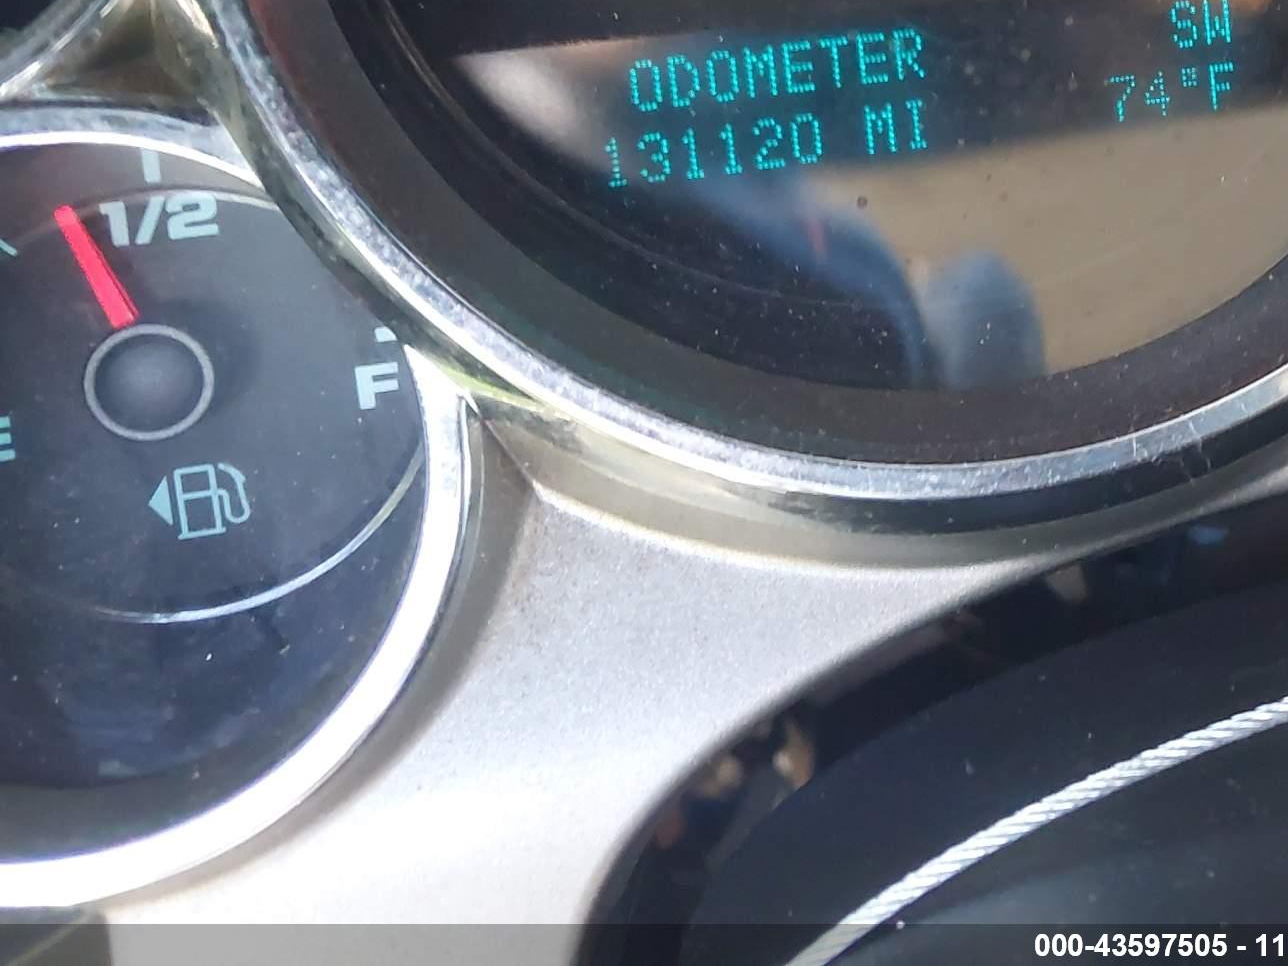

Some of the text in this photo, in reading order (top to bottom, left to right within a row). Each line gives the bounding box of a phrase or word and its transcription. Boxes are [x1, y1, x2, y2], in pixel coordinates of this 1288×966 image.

[629, 27, 925, 112] ODOMETER
[1109, 61, 1234, 122] 74°F
[604, 97, 928, 189] 131120 MI
[100, 198, 220, 246] 1/2
[354, 362, 399, 410] F
